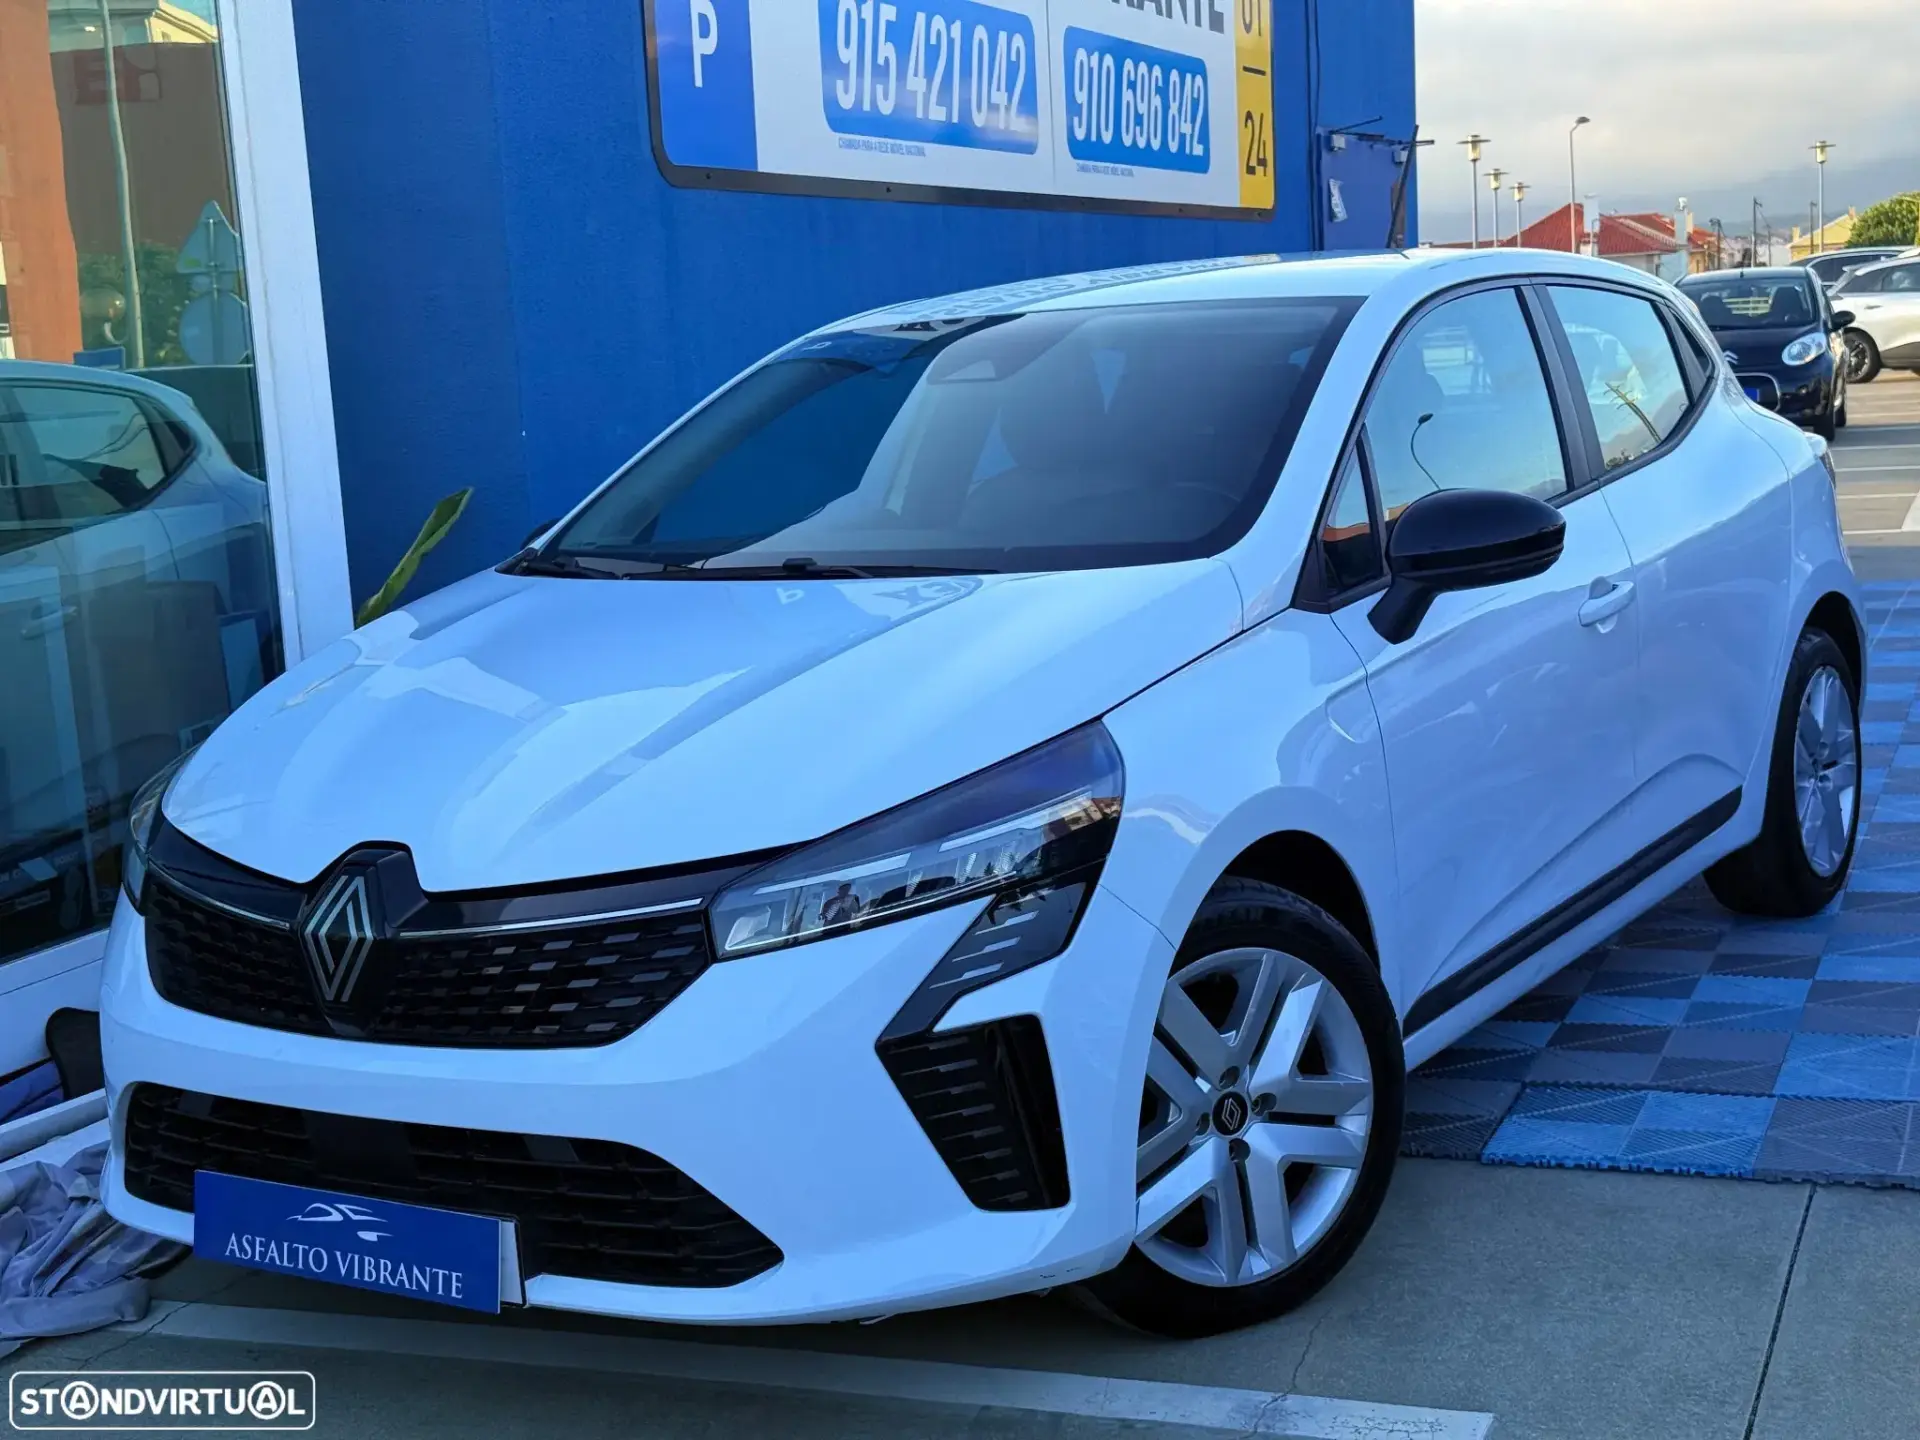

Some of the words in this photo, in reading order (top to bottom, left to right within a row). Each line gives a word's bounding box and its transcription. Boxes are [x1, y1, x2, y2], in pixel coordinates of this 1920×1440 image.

[690, 0, 718, 88] P
[836, 0, 897, 116] 915
[906, 11, 962, 124] 421
[971, 24, 1028, 133] 042
[1073, 47, 1115, 144] 910
[1121, 57, 1163, 151] 696
[1167, 68, 1205, 156] 842
[1244, 110, 1268, 177] 24
[225, 1232, 328, 1273] ASFALTO
[334, 1250, 463, 1299] VIBRANTE
